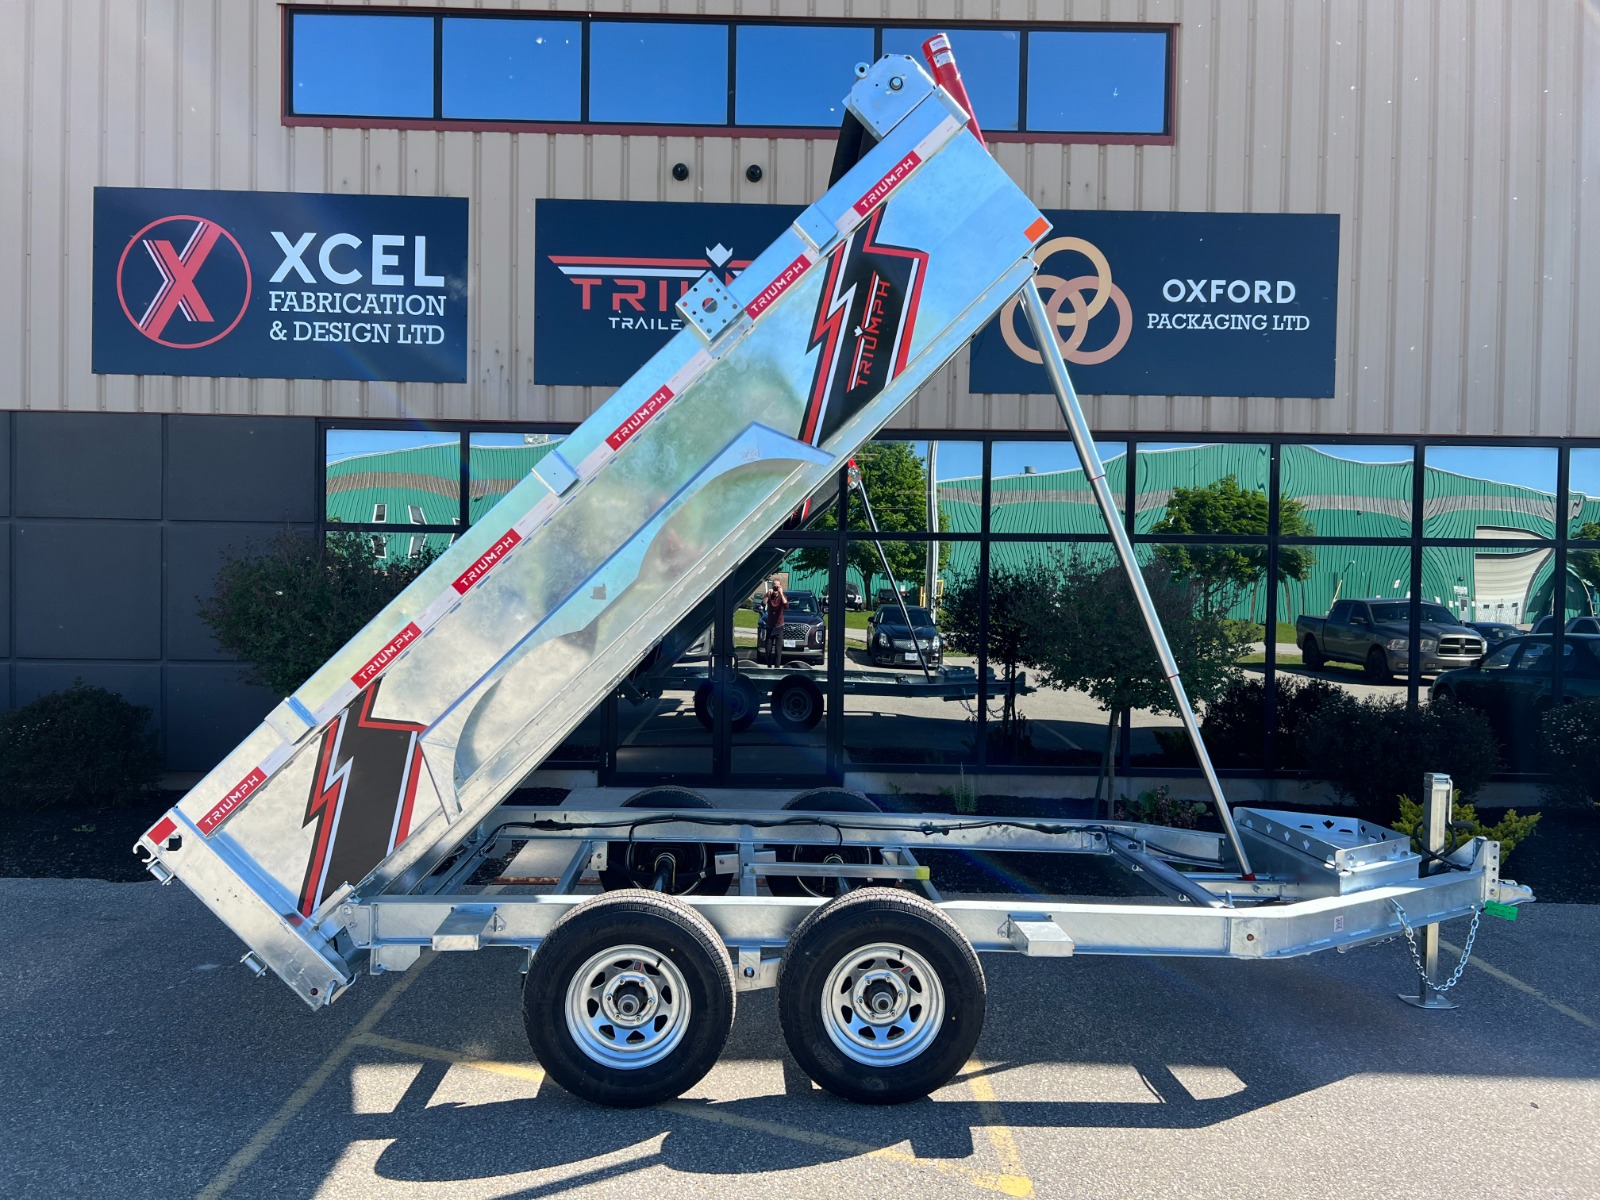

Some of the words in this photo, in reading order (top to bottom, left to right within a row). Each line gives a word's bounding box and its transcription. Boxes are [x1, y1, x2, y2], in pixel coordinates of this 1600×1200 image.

[860, 158, 914, 209] TRIUMPH
[268, 231, 445, 287] XCEL
[268, 291, 447, 317] FABRICATION
[750, 261, 804, 313] TRIUMPH
[1162, 279, 1296, 304] OXFORD
[269, 321, 287, 341] &
[293, 321, 390, 344] DESIGN
[397, 324, 445, 345] LTD
[855, 280, 891, 387] TRIUMPH
[1147, 313, 1268, 331] PACKAGING
[1272, 315, 1310, 331] LTD
[613, 392, 667, 443] TRIUMPH
[460, 536, 514, 587] TRIUMPH
[359, 630, 414, 681] TRIUMPH
[204, 775, 259, 826] TRIUMPH
